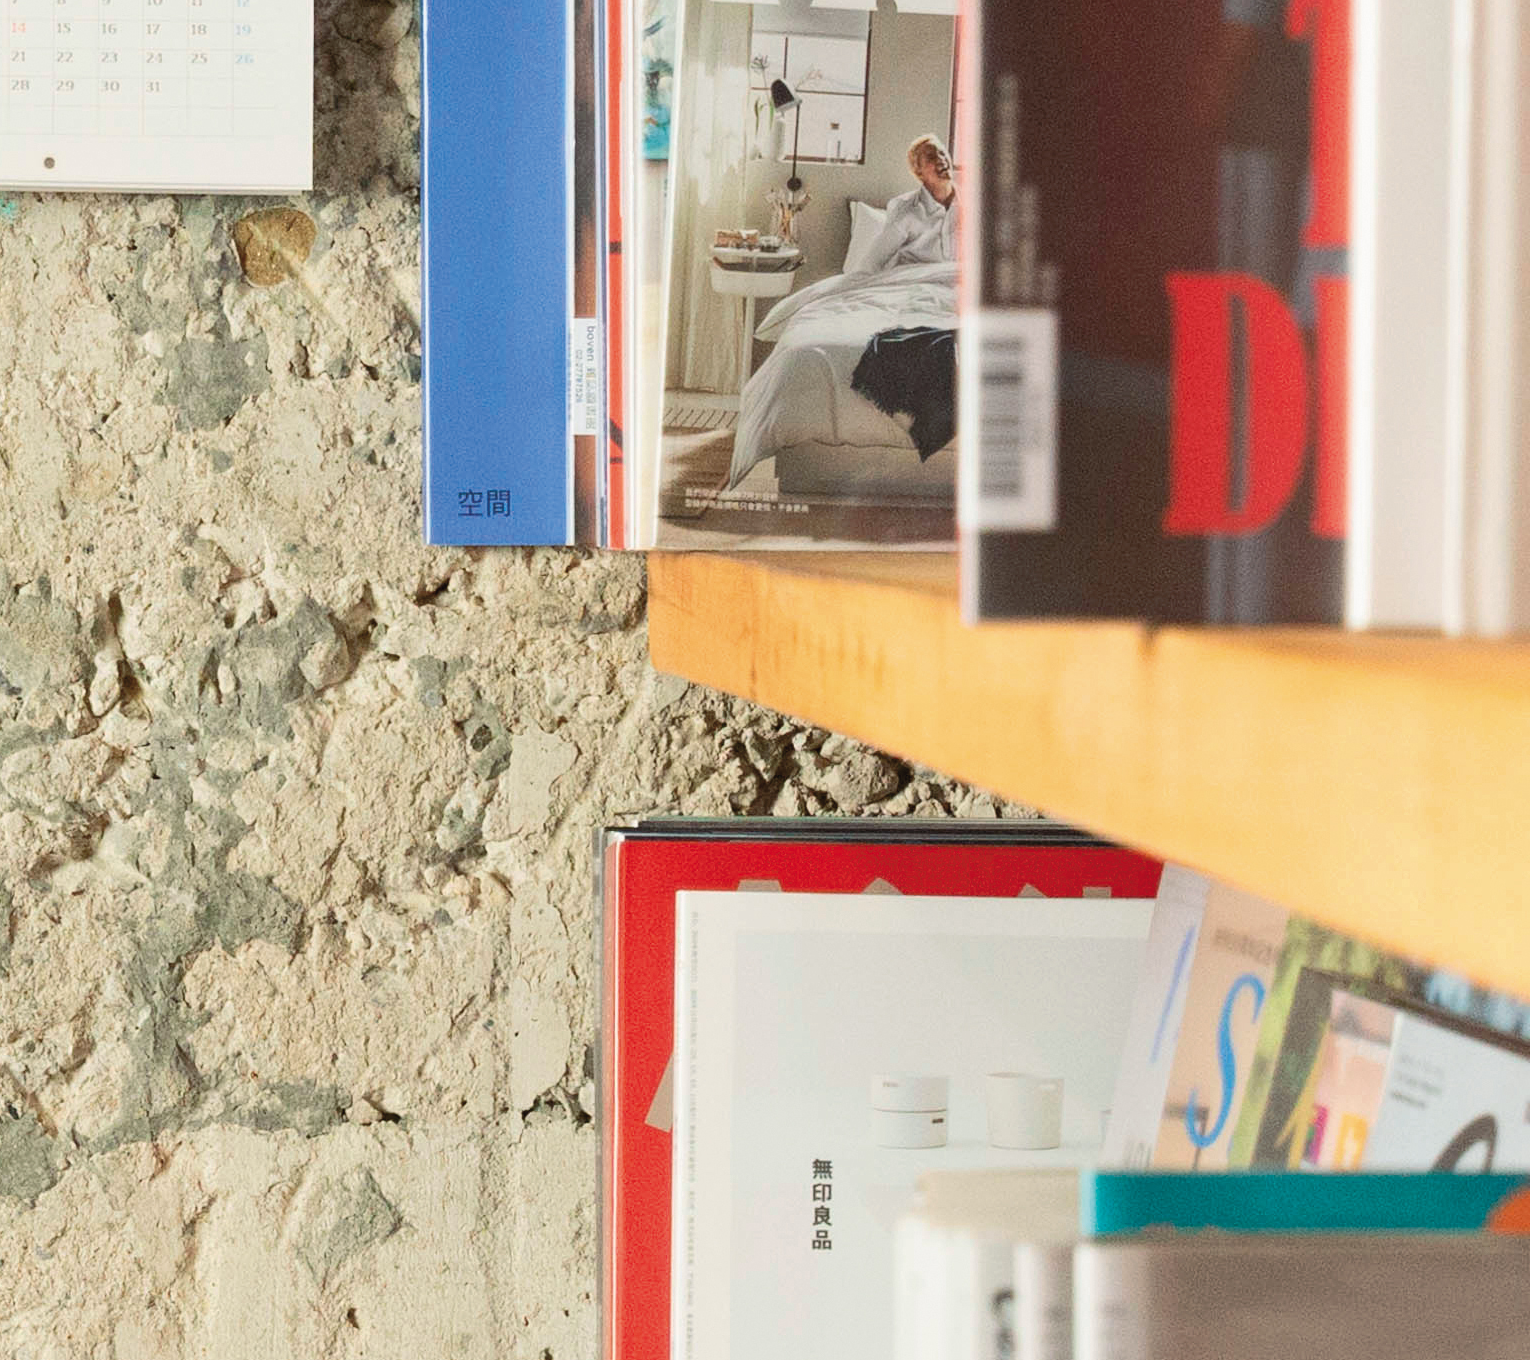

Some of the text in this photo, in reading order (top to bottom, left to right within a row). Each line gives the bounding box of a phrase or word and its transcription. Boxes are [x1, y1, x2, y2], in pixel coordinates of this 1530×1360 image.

[11, 22, 27, 33] 14
[56, 23, 71, 34] 15
[101, 23, 117, 34] 16
[146, 23, 162, 35] 17
[190, 24, 208, 35] 18
[11, 51, 26, 62] 21
[56, 51, 74, 63] 22
[101, 52, 119, 63] 23
[146, 52, 163, 64] 24
[190, 52, 209, 64] 25
[11, 79, 30, 91] 28
[56, 80, 75, 92] 29
[101, 80, 120, 92] 30
[146, 80, 161, 93] 31
[586, 325, 596, 362] boven
[456, 488, 512, 520] 空間
[811, 1158, 833, 1252] 無印良品
